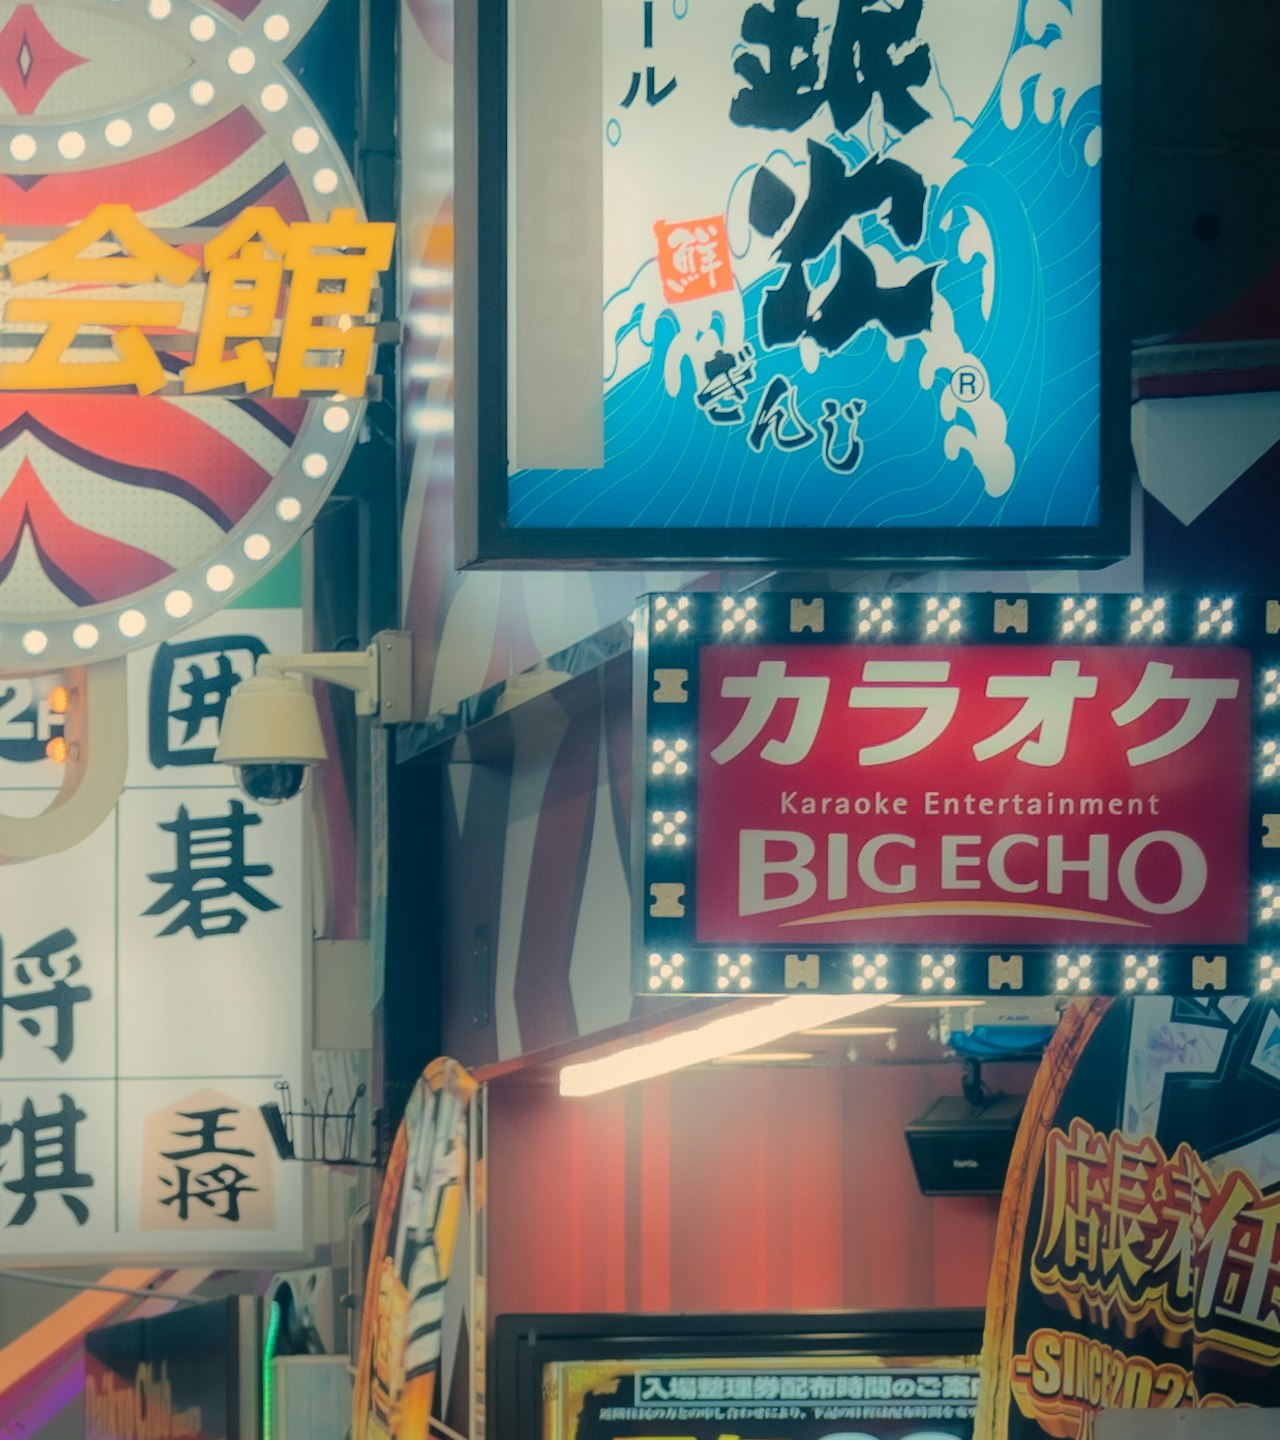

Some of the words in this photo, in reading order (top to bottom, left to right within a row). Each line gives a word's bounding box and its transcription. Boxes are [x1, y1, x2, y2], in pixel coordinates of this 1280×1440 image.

[666, 224, 723, 292] 鮮
[697, 345, 865, 473] ぎんじ
[710, 660, 1238, 766] カラオケ
[140, 635, 282, 938] 囲碁
[781, 790, 909, 816] Karaoke
[924, 790, 1160, 816] Entertainment
[739, 828, 917, 916] BIG
[941, 828, 1208, 915] ECHO
[159, 1107, 260, 1222] 王将
